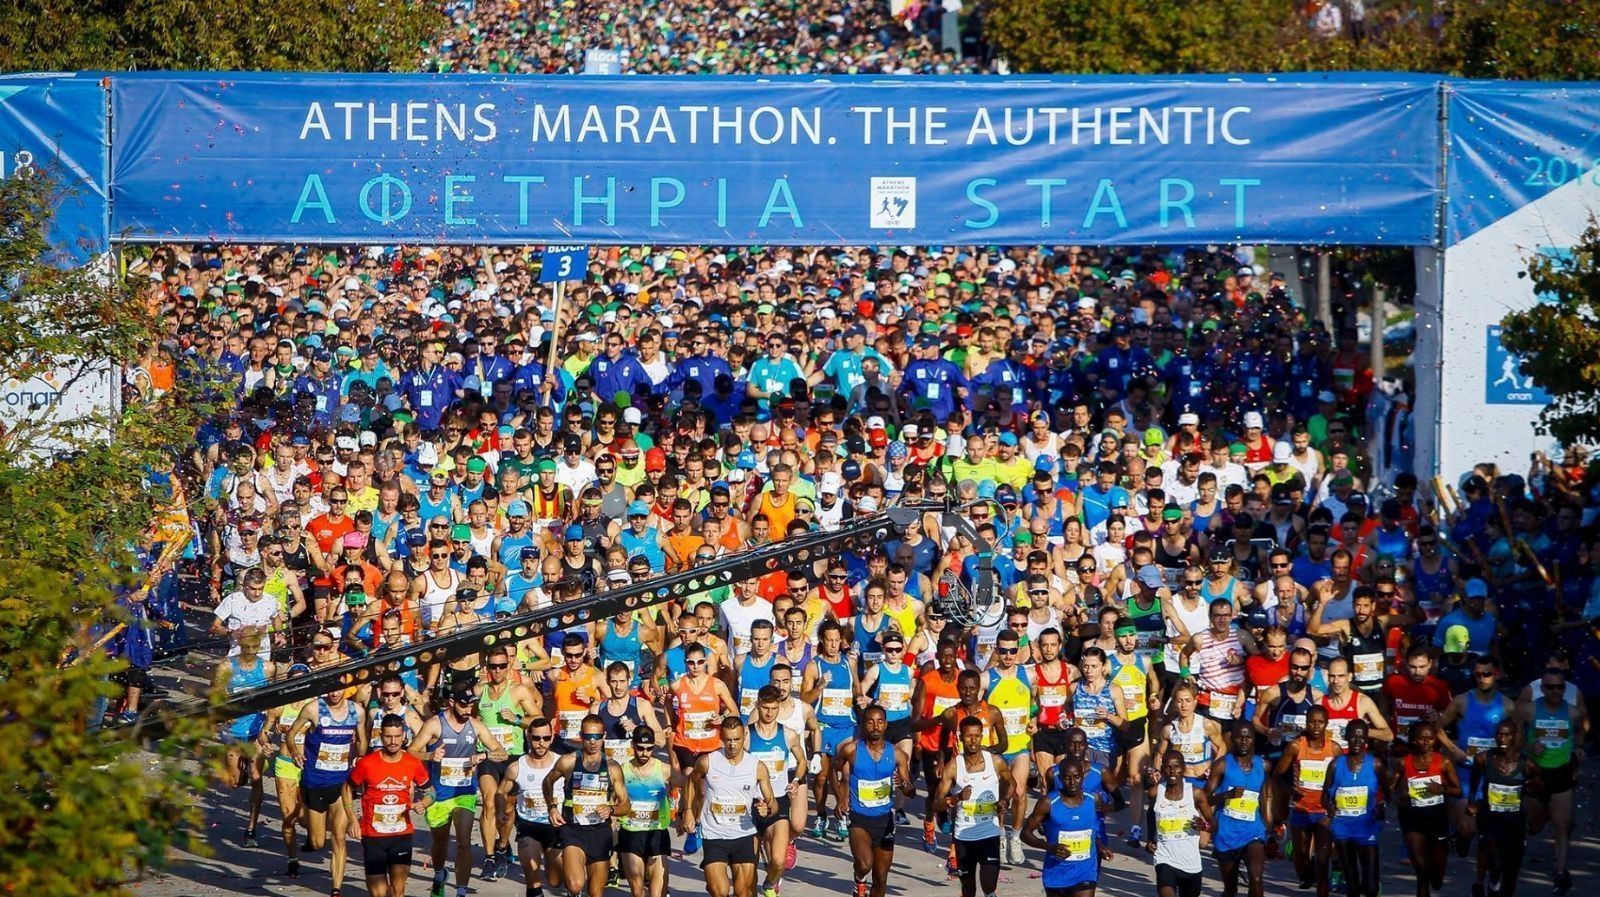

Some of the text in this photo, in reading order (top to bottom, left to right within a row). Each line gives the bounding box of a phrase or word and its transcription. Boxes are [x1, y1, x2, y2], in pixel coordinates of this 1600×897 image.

[300, 101, 1252, 147] ATHENS MARATHON. THE AUTHENTIC
[290, 172, 804, 229] ΑΦΕΤΗΡΙΑ
[965, 177, 1262, 230] START
[557, 255, 572, 277] 3
[1344, 795, 1358, 805] 103
[1502, 794, 1508, 802] 2
[721, 805, 736, 813] 203
[635, 811, 650, 819] 205
[1072, 841, 1081, 849] 11
